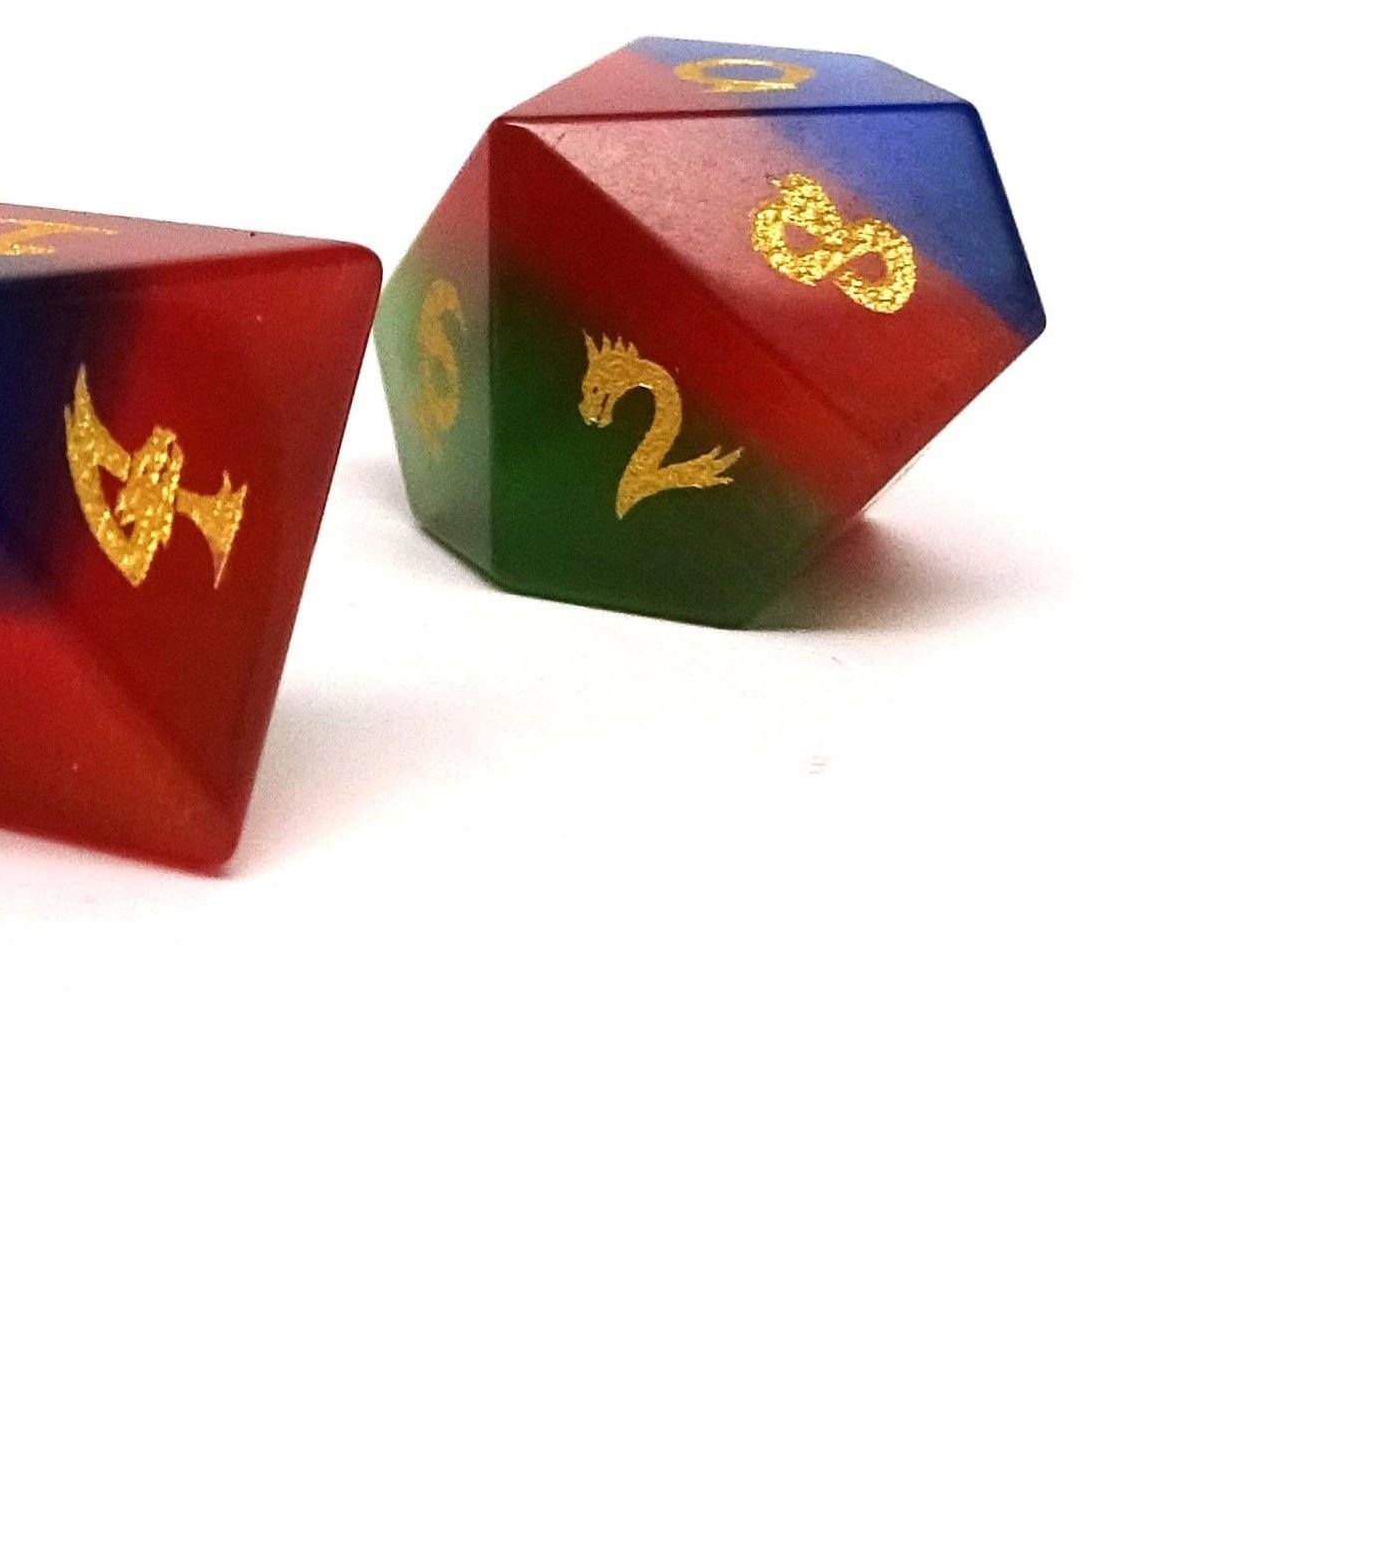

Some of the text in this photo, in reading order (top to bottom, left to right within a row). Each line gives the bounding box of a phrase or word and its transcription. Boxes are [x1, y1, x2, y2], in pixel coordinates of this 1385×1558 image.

[750, 170, 918, 315] 8
[63, 362, 250, 590] 4
[576, 329, 746, 520] 2
